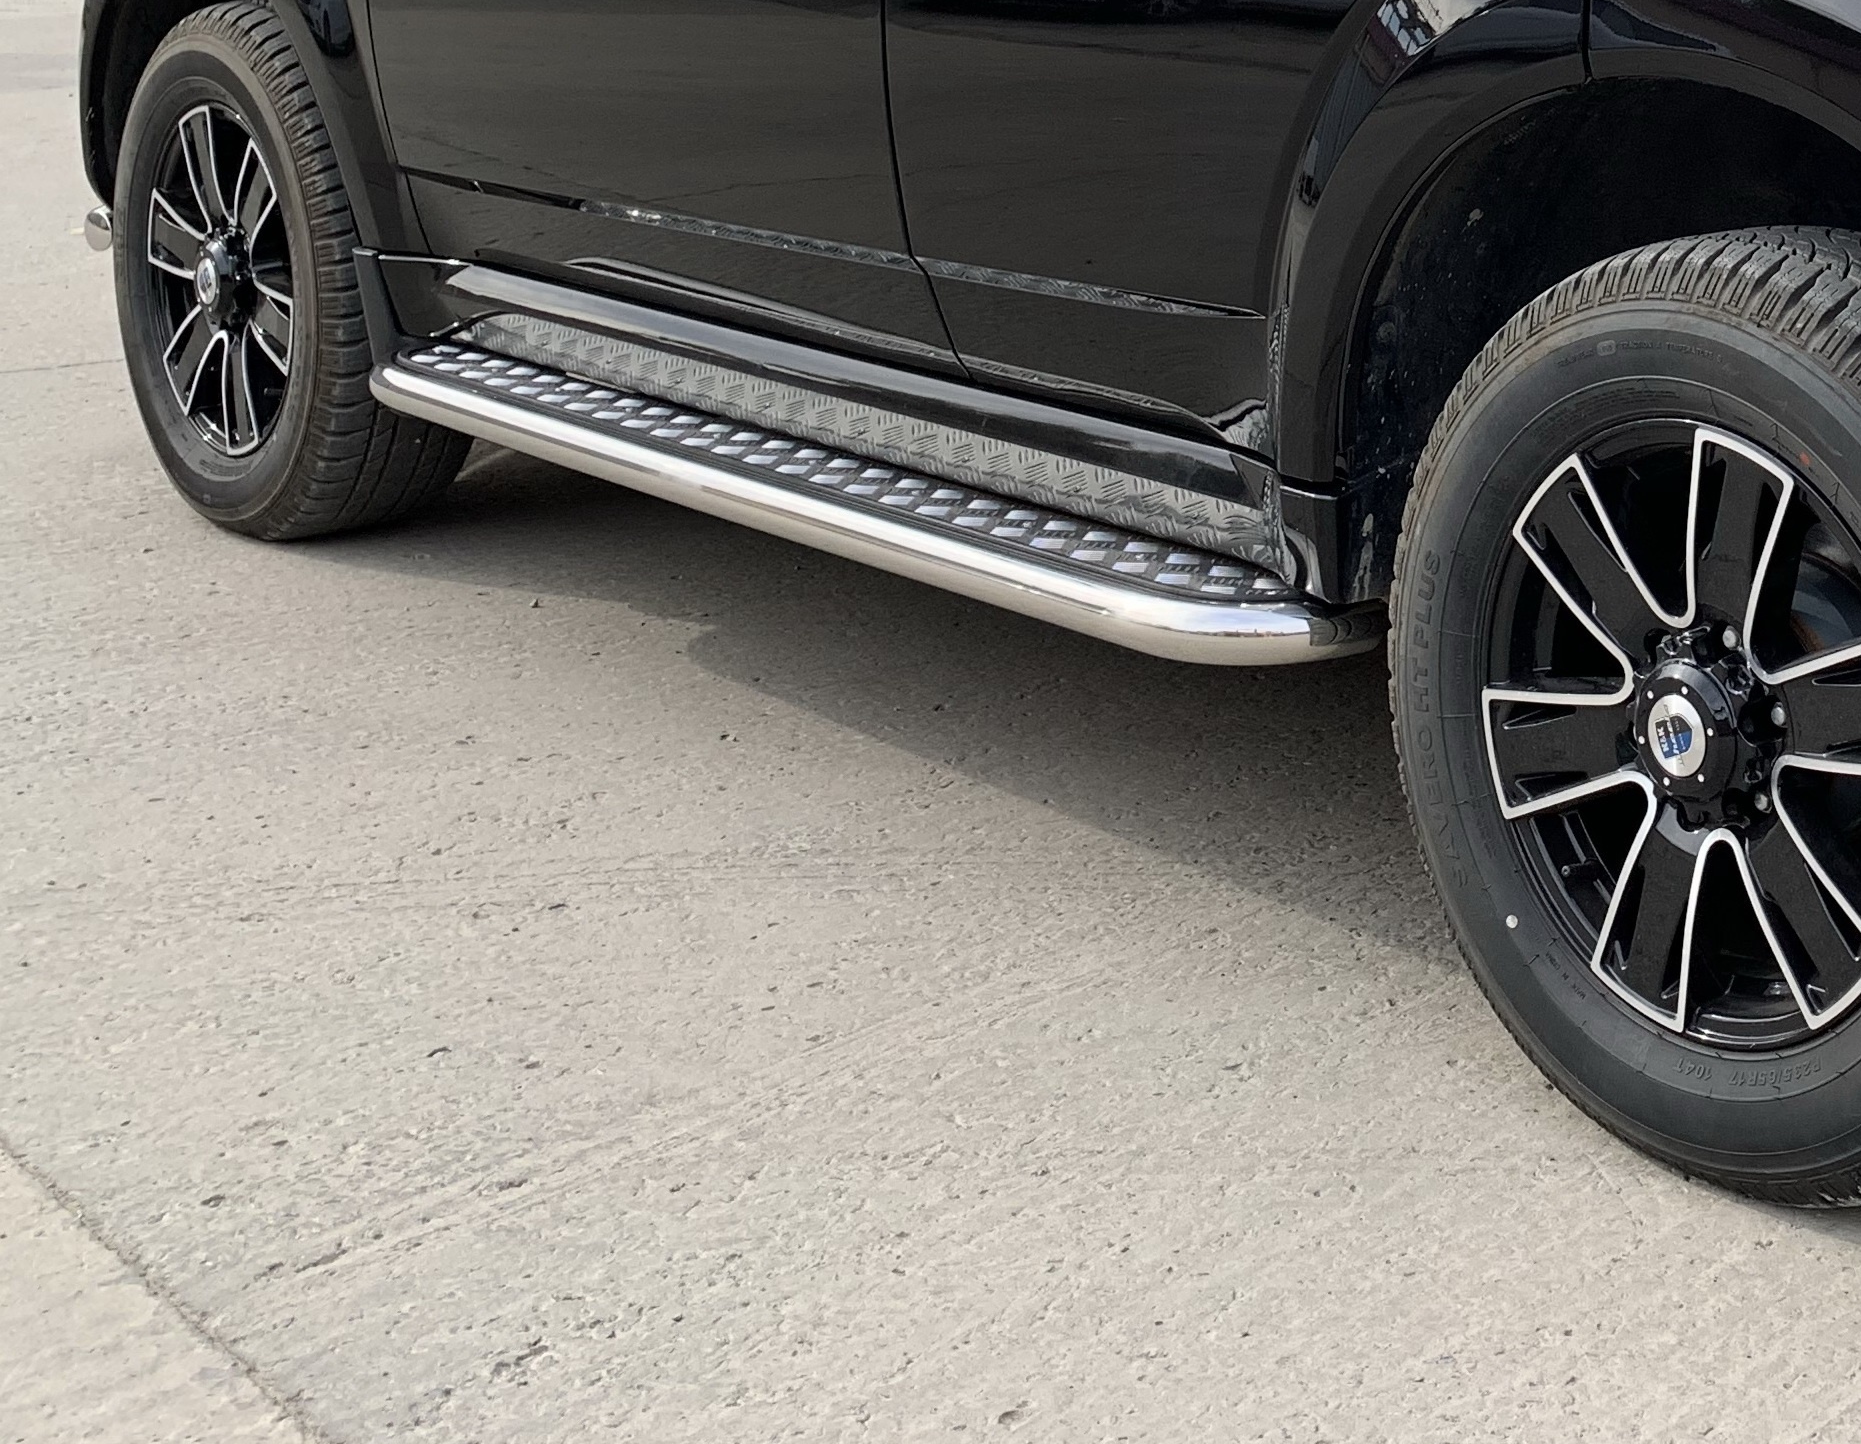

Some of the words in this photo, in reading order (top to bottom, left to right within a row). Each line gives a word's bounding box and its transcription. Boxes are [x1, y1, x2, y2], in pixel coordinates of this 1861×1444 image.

[1412, 549, 1442, 650] PLUS
[1412, 657, 1430, 713] HT
[1416, 724, 1469, 889] SAVERO
[1671, 1057, 1714, 1082] 104T
